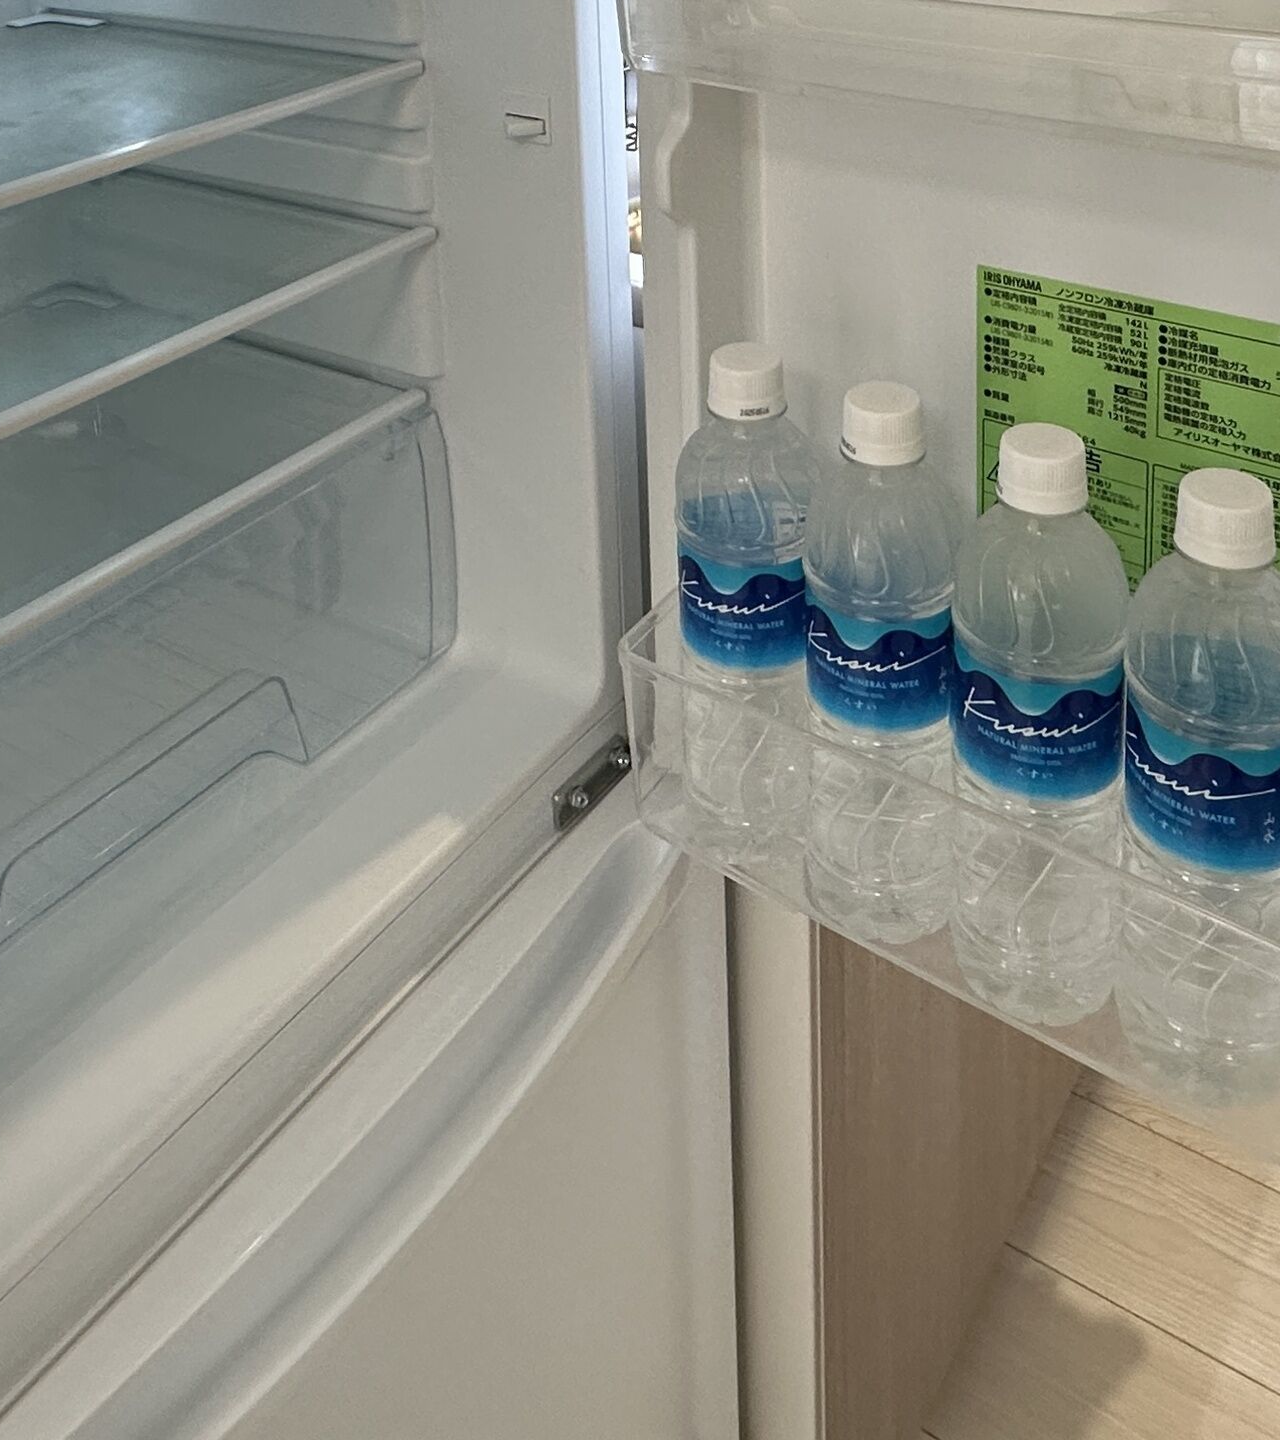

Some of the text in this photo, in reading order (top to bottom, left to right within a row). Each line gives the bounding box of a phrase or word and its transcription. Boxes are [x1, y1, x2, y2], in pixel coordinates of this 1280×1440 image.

[983, 270, 1042, 293] IRIS OHYAMA
[847, 675, 887, 690] MINERAL
[889, 679, 920, 690] WATER
[977, 724, 1098, 756] NATURAL MINERAL WATER
[1151, 788, 1196, 816] MINERAL
[1199, 810, 1237, 826] WATER
